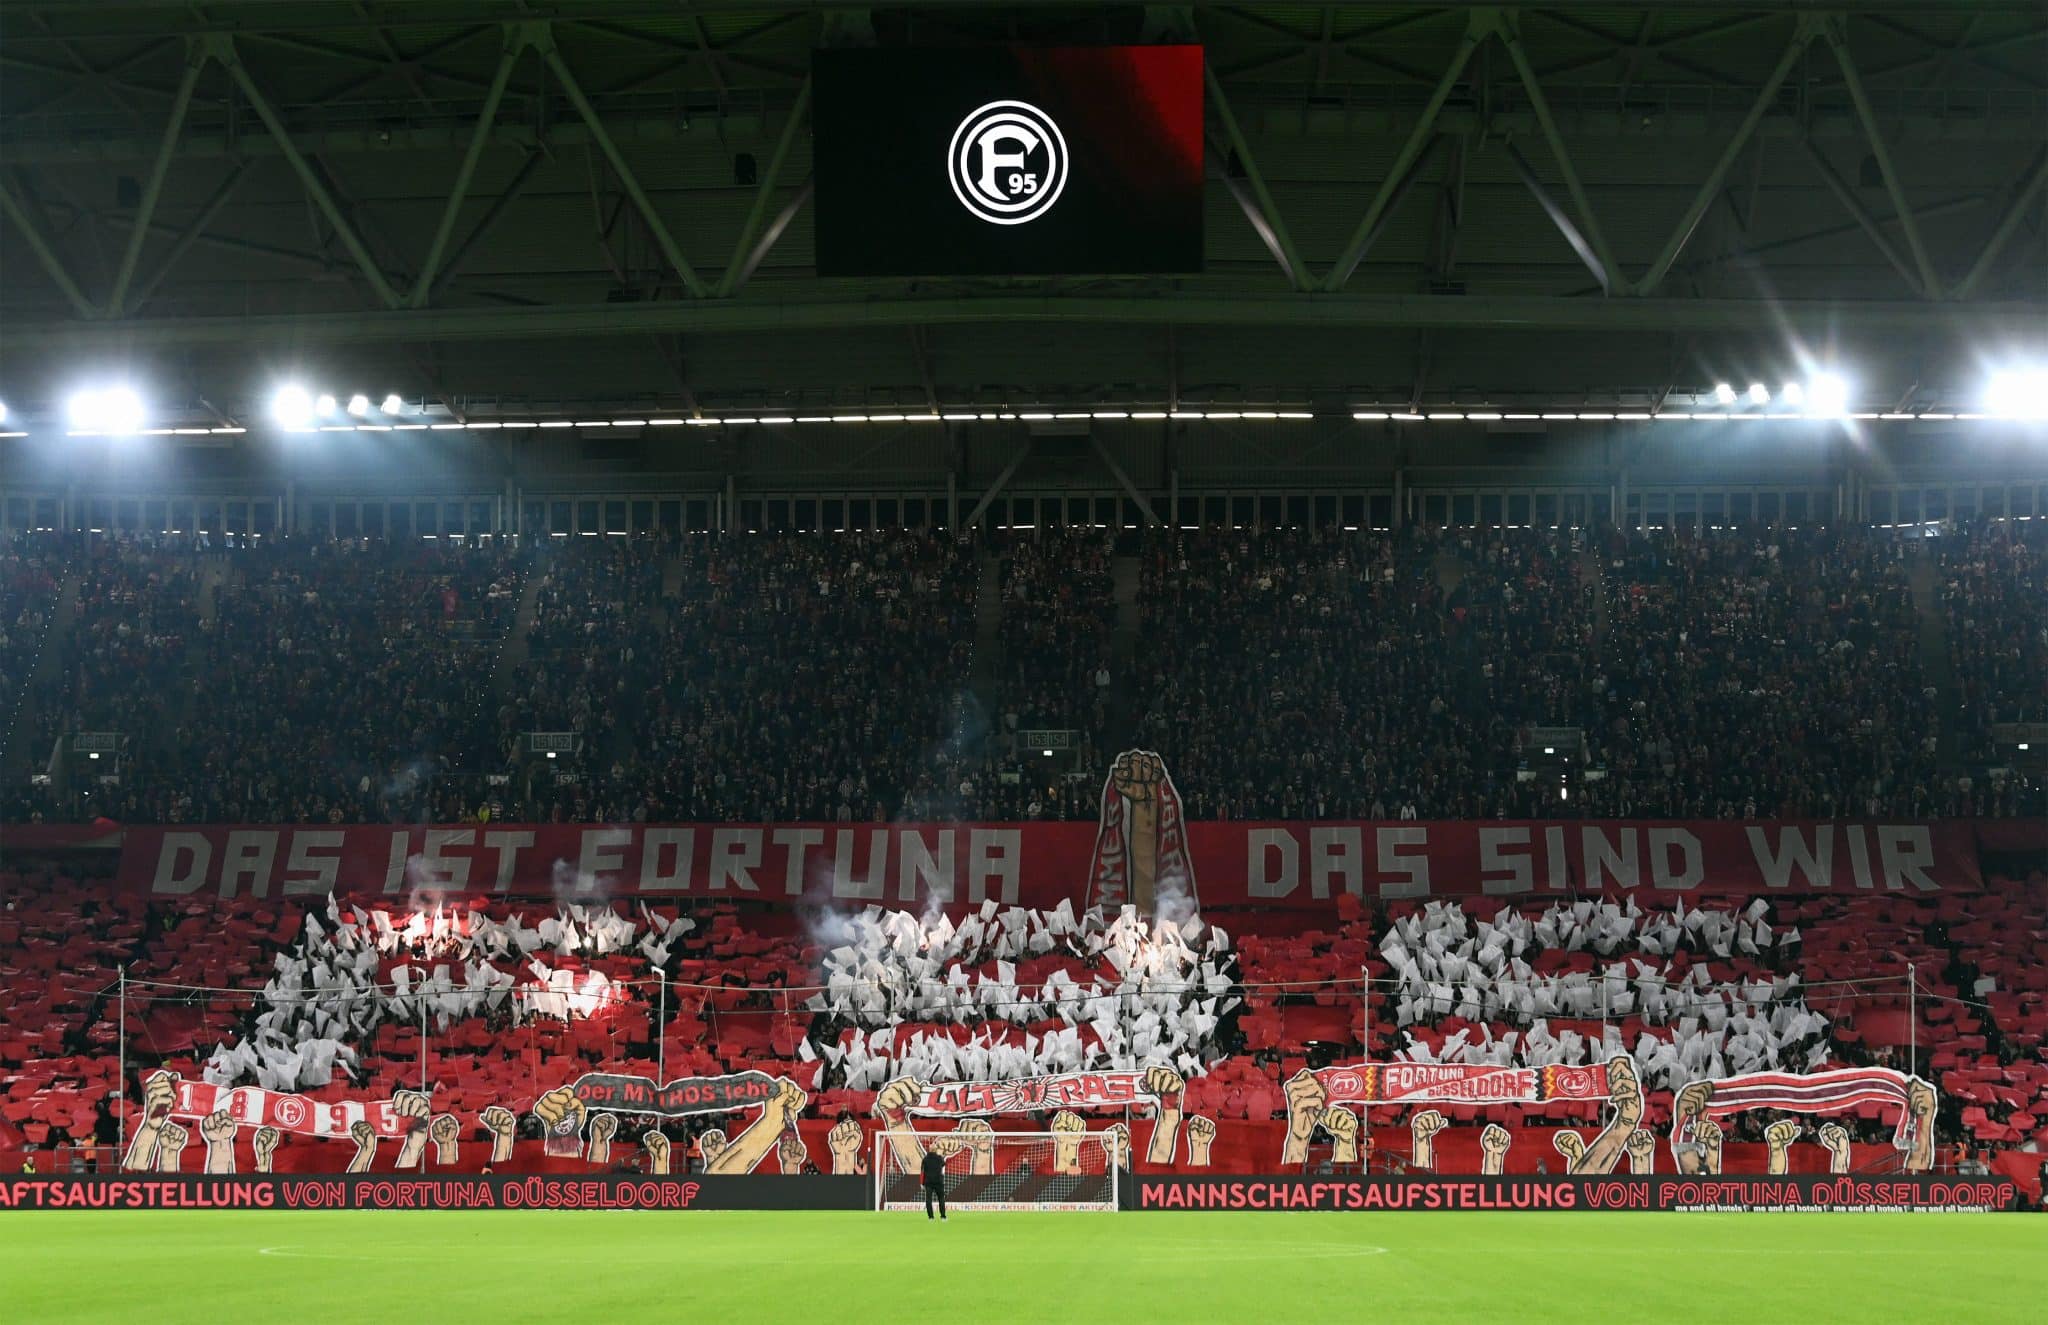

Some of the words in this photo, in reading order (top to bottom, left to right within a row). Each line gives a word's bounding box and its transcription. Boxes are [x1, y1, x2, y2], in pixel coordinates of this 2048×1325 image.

[151, 830, 346, 898] DAS
[382, 828, 536, 893] IST
[574, 828, 1022, 903] FORTUNA
[1247, 826, 1431, 899] DAS
[1478, 826, 1705, 895] SIND
[1744, 824, 1942, 891] WIR
[725, 1081, 769, 1101] lebt
[1386, 1067, 1464, 1097] FORTUNA
[1427, 1070, 1534, 1099] DÜSSELDORF
[282, 1181, 346, 1208] VON
[354, 1181, 495, 1208] FORTUNA
[503, 1176, 701, 1208] DÜSSELDORF
[1141, 1182, 1577, 1208] MANNSCHAFTSAUFSTELLUNG
[1583, 1182, 1649, 1208] VON
[1660, 1182, 1802, 1208] FORTUNA
[1811, 1176, 2015, 1209] DÜSSELDORF
